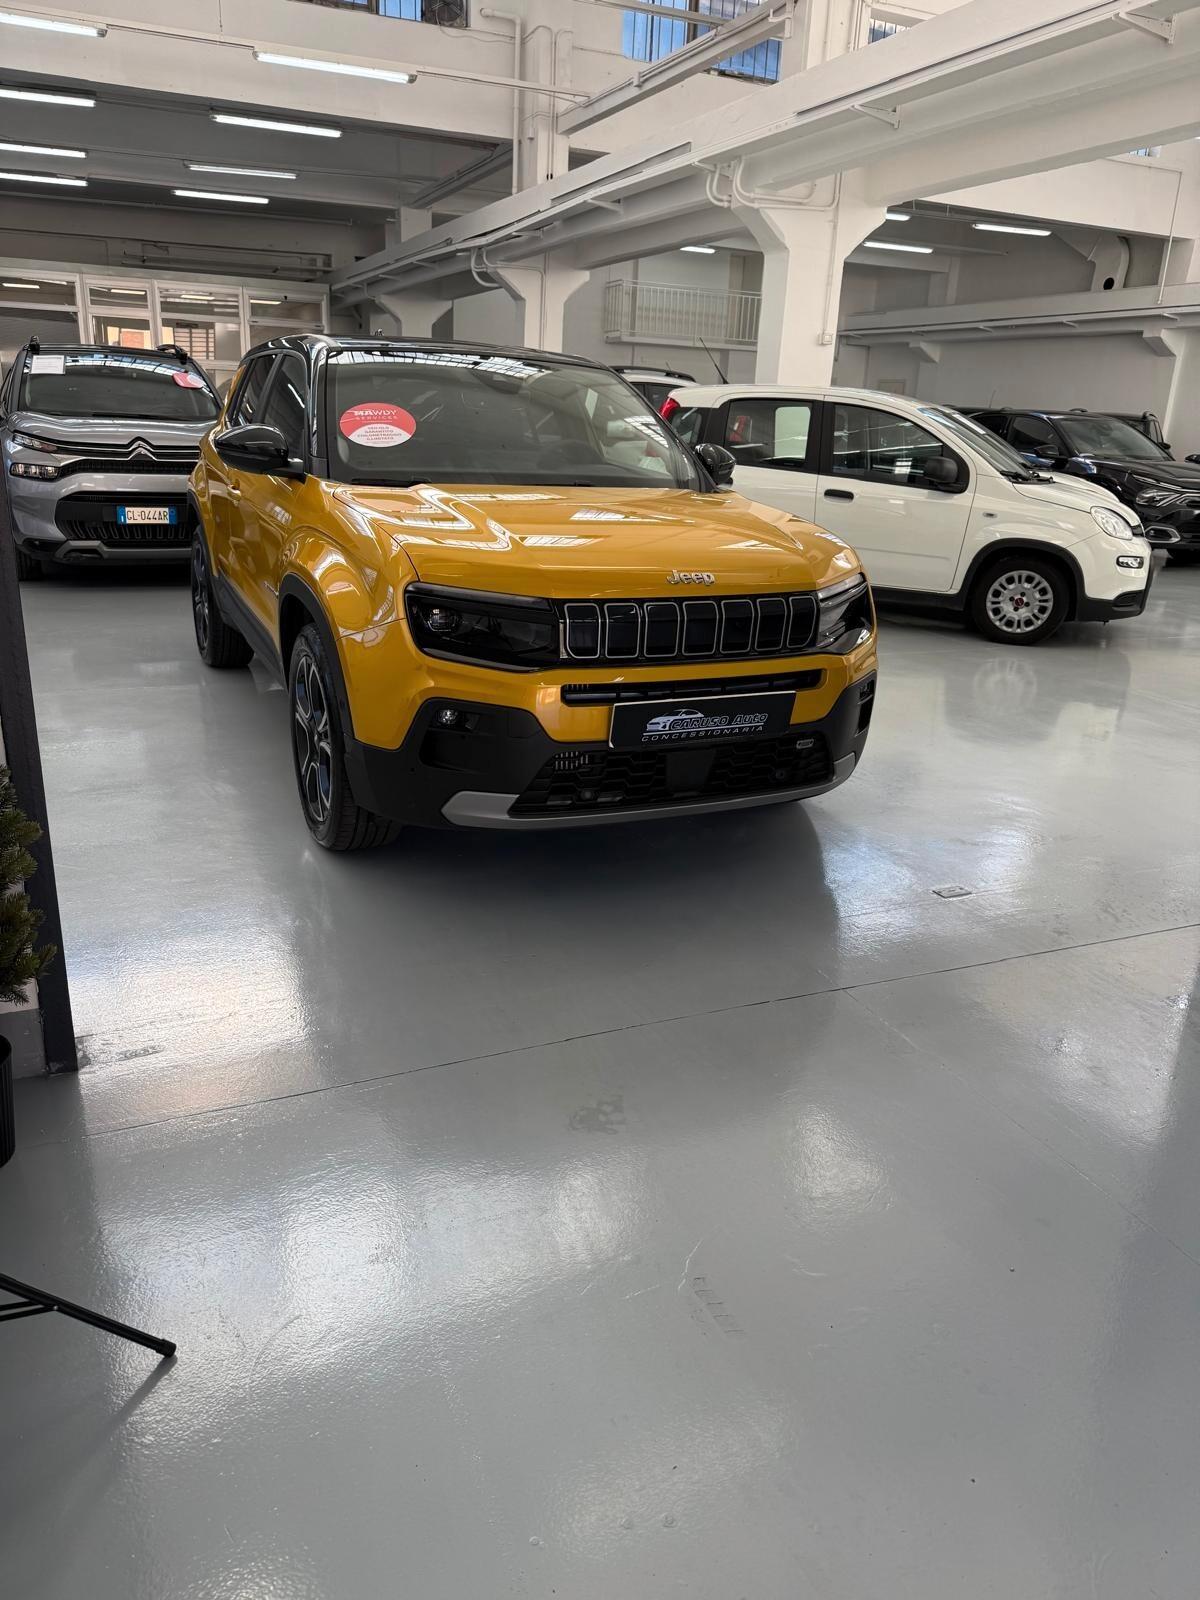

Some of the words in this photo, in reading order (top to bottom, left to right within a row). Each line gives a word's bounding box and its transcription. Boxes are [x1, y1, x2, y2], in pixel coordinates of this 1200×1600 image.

[666, 569, 716, 587] Jeep
[670, 715, 730, 731] CARUSO
[641, 725, 764, 742] CONCESSIONARIA
